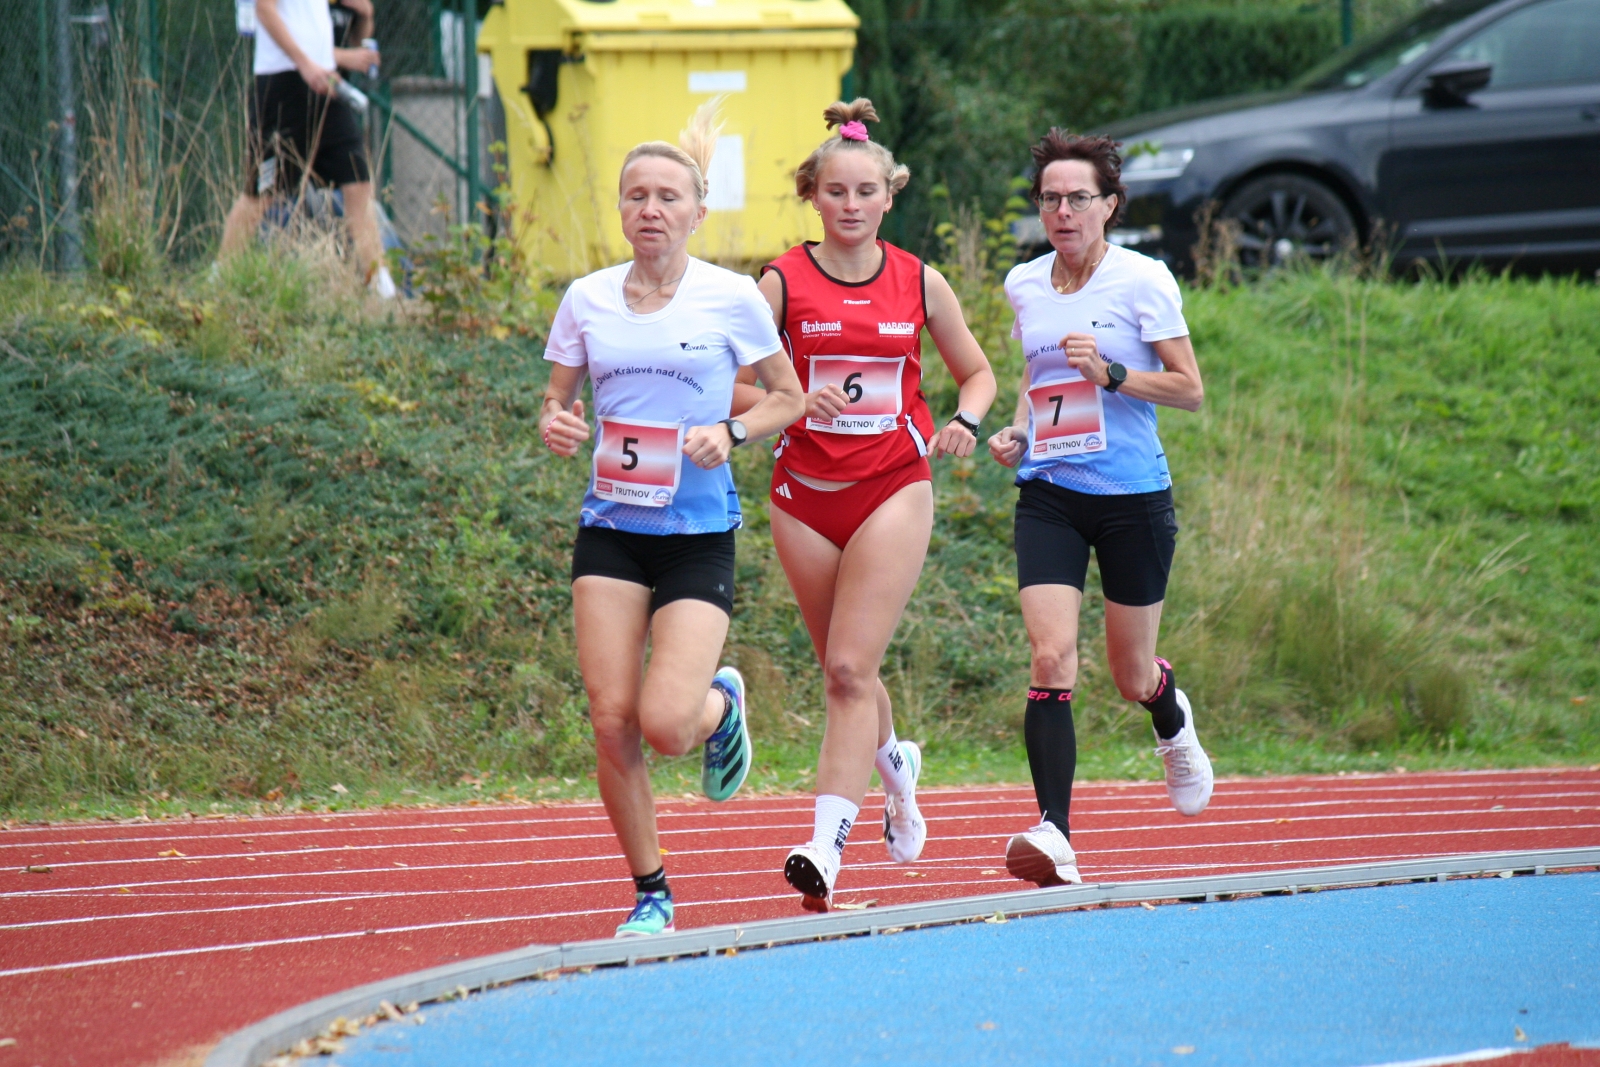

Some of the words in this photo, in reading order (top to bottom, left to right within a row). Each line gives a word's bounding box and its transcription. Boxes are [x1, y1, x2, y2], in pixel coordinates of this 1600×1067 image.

[801, 320, 842, 334] Krakonoš
[878, 322, 915, 330] MARATON
[613, 365, 653, 377] Králové
[655, 367, 676, 378] nad
[676, 372, 704, 396] Labem
[842, 371, 864, 404] 6
[1048, 394, 1064, 427] 7
[835, 419, 875, 429] TRUTNOV
[1048, 440, 1082, 452] TRUTNOV
[621, 436, 639, 471] 5
[614, 486, 650, 499] TRUTNOV
